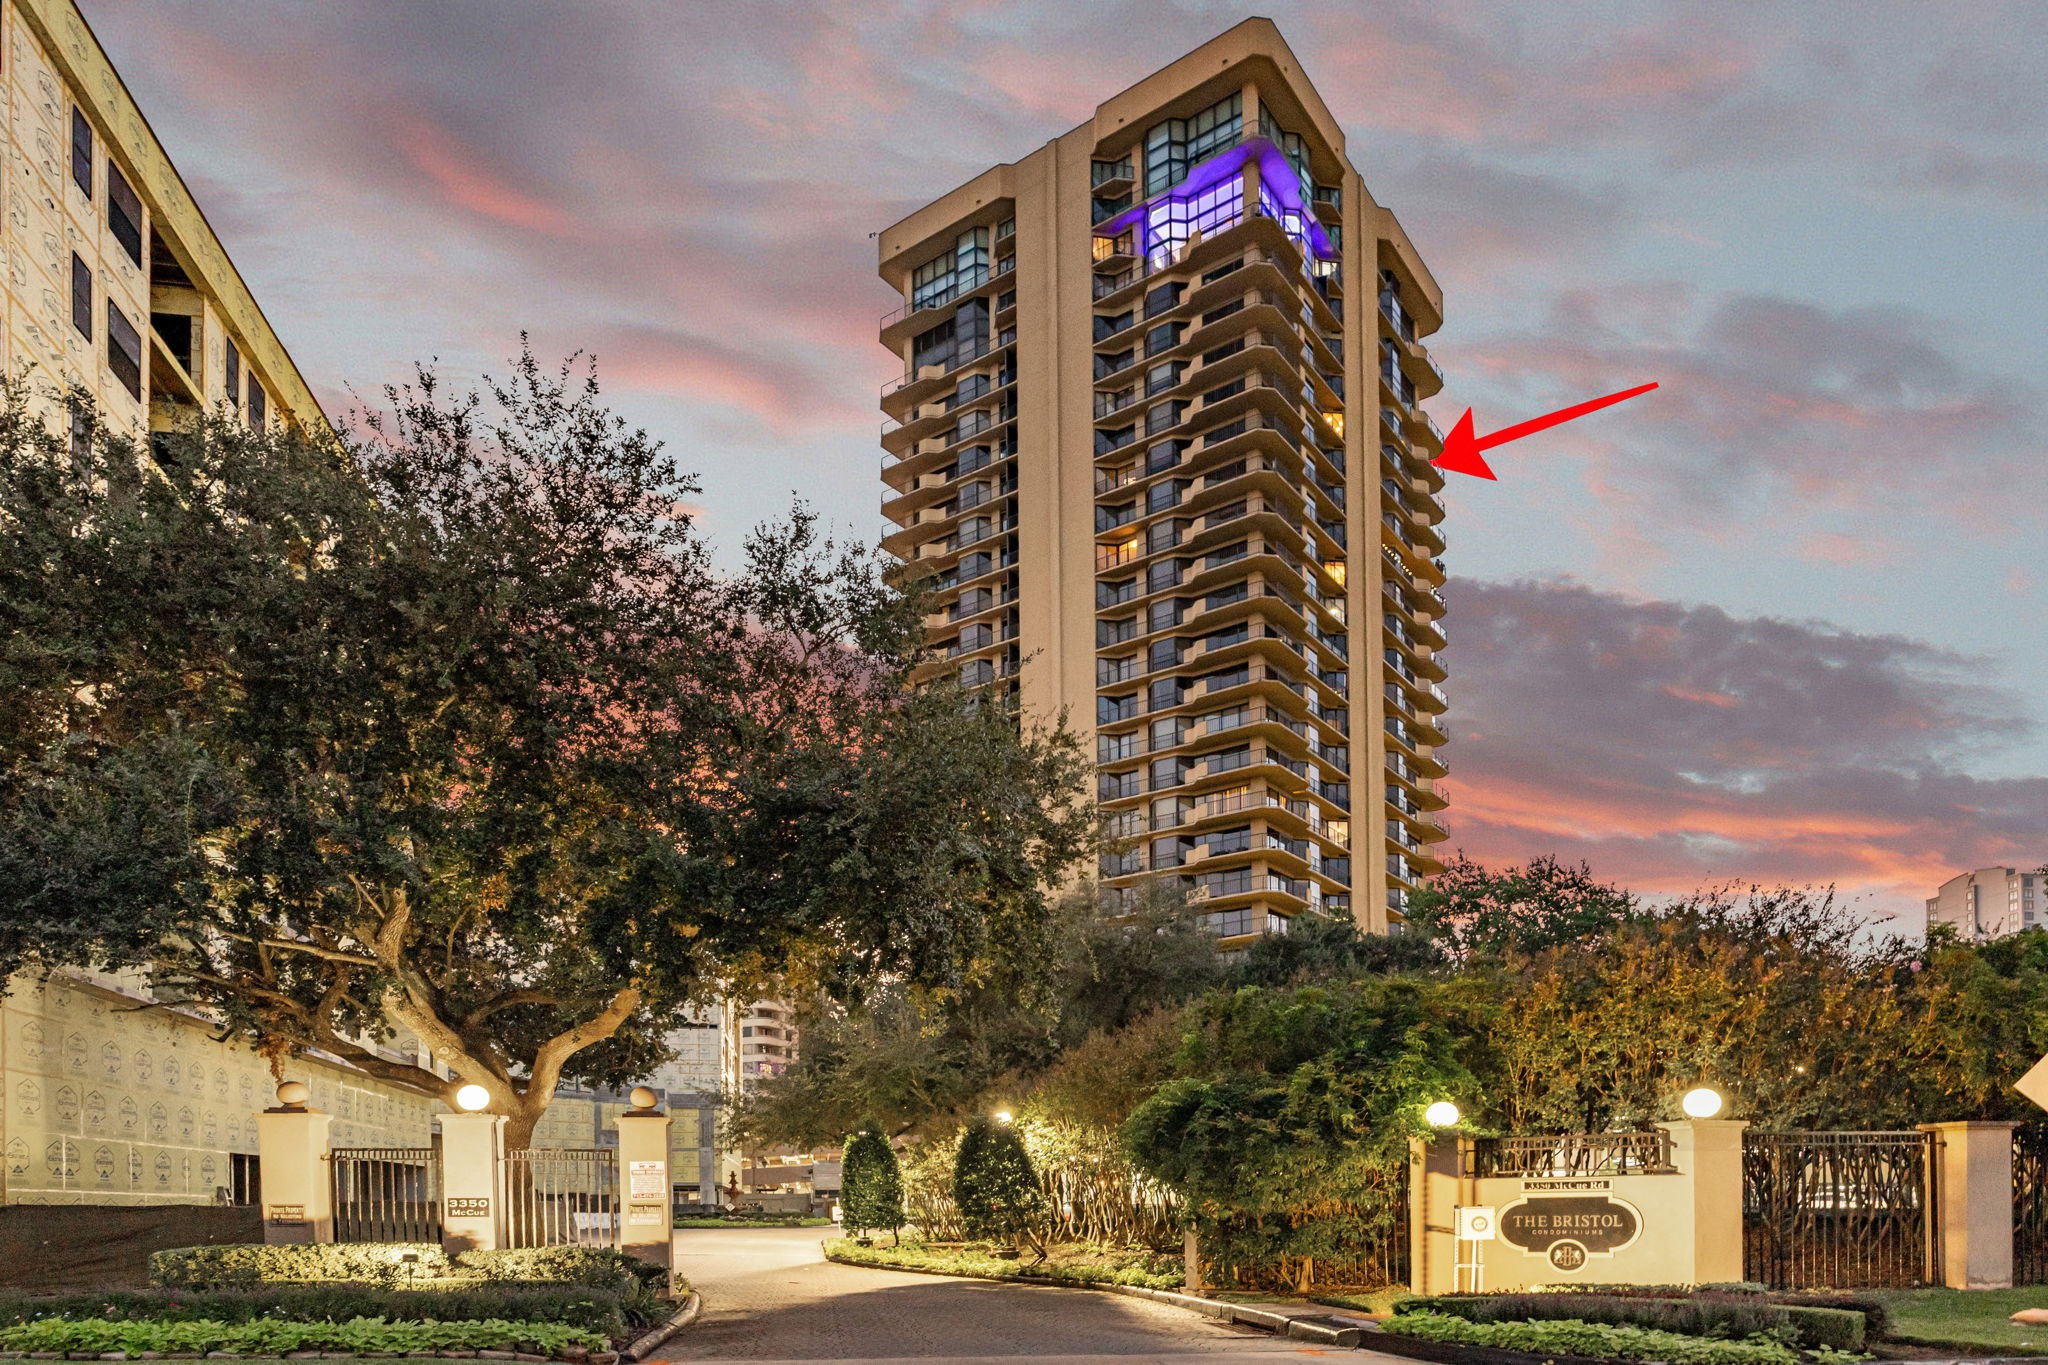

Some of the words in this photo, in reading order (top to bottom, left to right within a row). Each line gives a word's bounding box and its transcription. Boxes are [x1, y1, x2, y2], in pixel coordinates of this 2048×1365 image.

[1554, 1181, 1588, 1189] McCue
[1590, 1181, 1604, 1189] Rd
[449, 1199, 488, 1207] 3350
[1513, 1215, 1548, 1227] THE
[1553, 1214, 1623, 1227] BRISTOL
